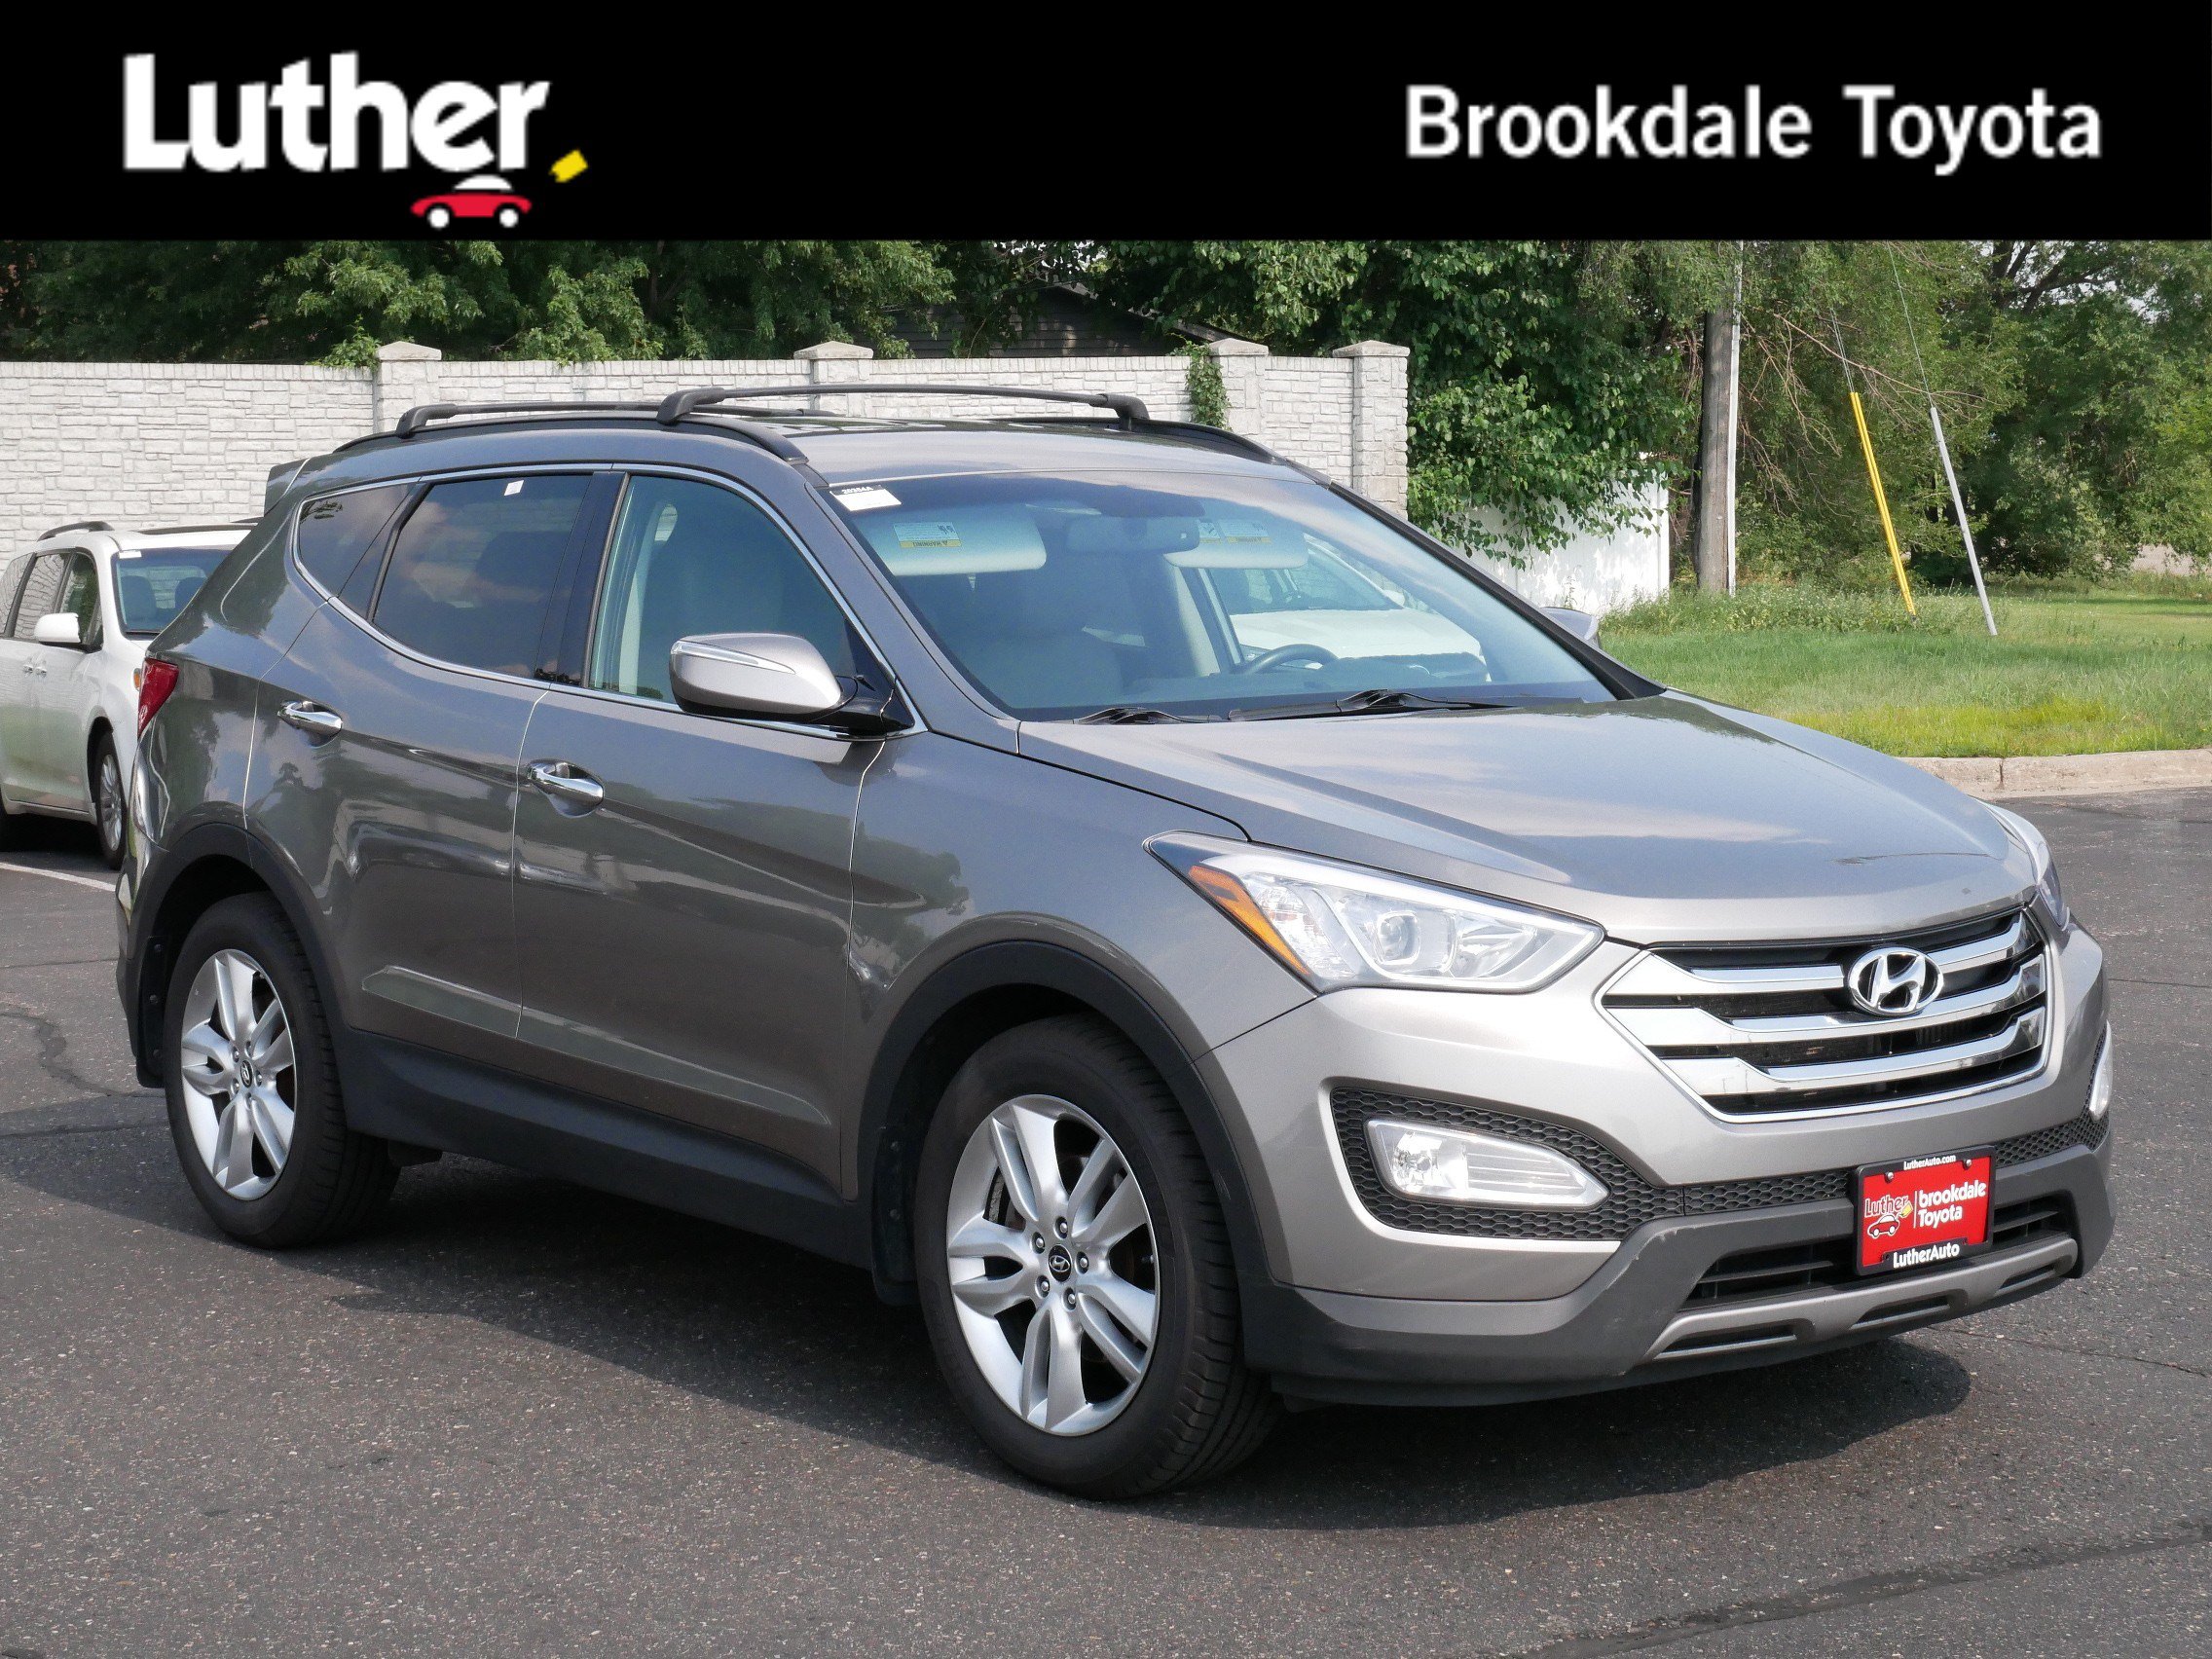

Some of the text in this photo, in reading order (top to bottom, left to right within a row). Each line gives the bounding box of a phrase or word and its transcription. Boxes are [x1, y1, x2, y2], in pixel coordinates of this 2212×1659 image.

[1903, 1155, 1956, 1170] LutherAuto.com
[1918, 1180, 1987, 1207] brookdale
[1864, 1195, 1908, 1218] Luther
[1917, 1204, 1963, 1229] Toyota
[1893, 1242, 1960, 1269] LutherAuto
